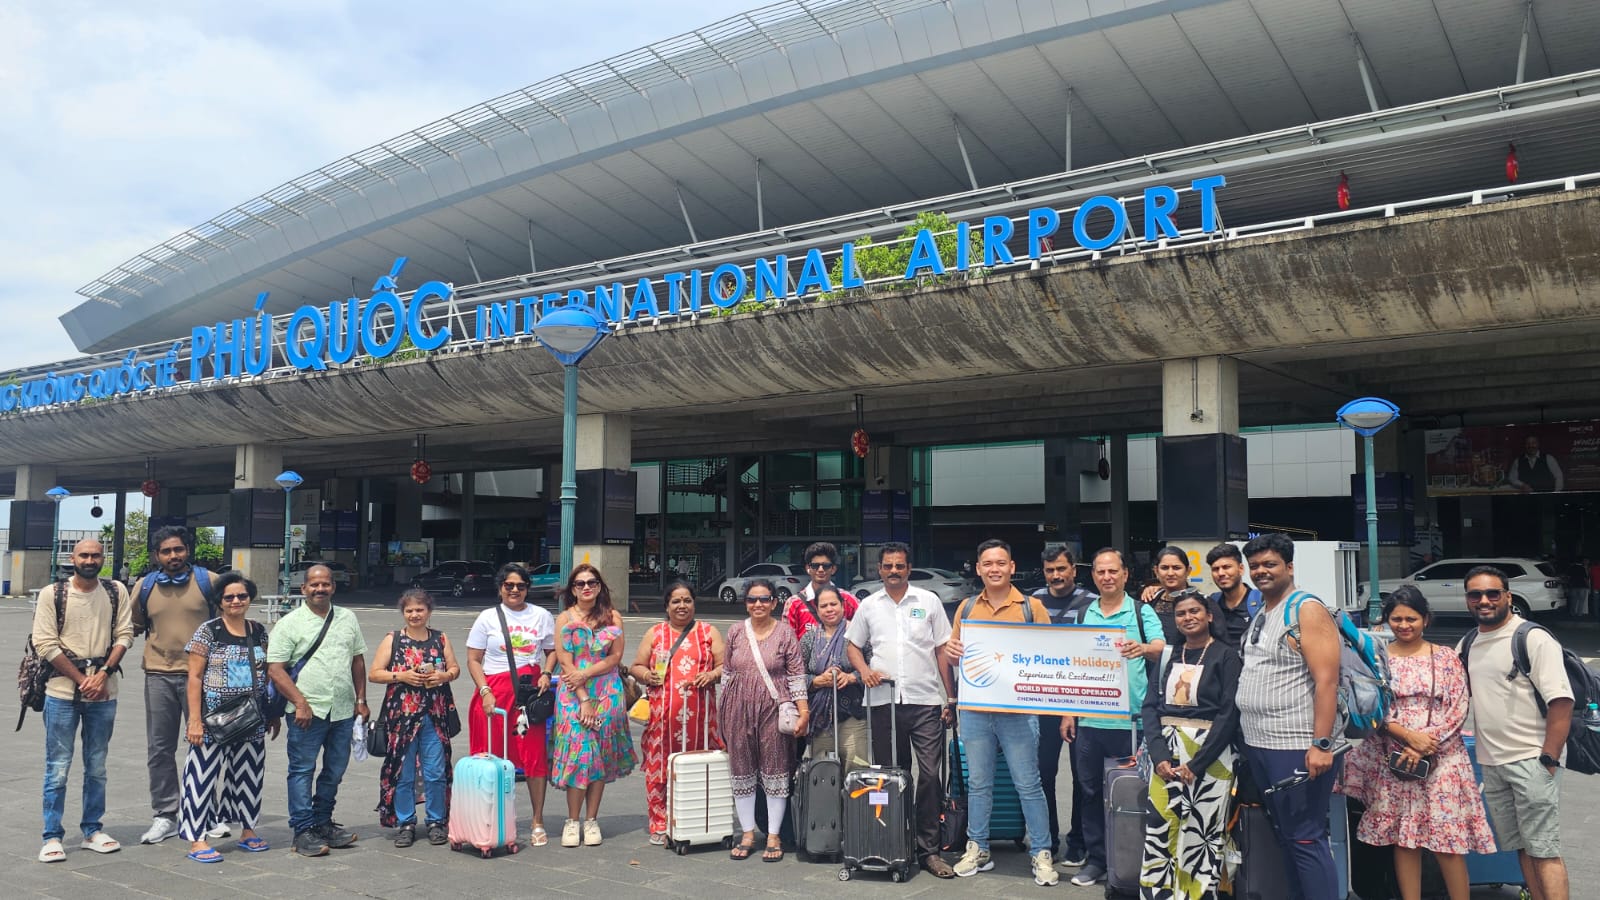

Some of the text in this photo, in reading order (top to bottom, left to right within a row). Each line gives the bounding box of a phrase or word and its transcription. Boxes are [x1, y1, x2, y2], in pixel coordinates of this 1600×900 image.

[904, 175, 1226, 280] AIRPORT
[21, 371, 86, 408] KHÔNG
[89, 349, 151, 399] QUỐC
[155, 340, 183, 388] TẾ
[190, 292, 273, 382] PHÚ
[286, 256, 453, 371] QUỐC
[1012, 653, 1121, 670] Sky Planet Holidays
[1018, 669, 1054, 680] Experience
[1055, 671, 1066, 679] the
[1016, 684, 1119, 697] WORLD WIDE TOUR OPERATOR
[1080, 699, 1120, 707] COIMBATORE
